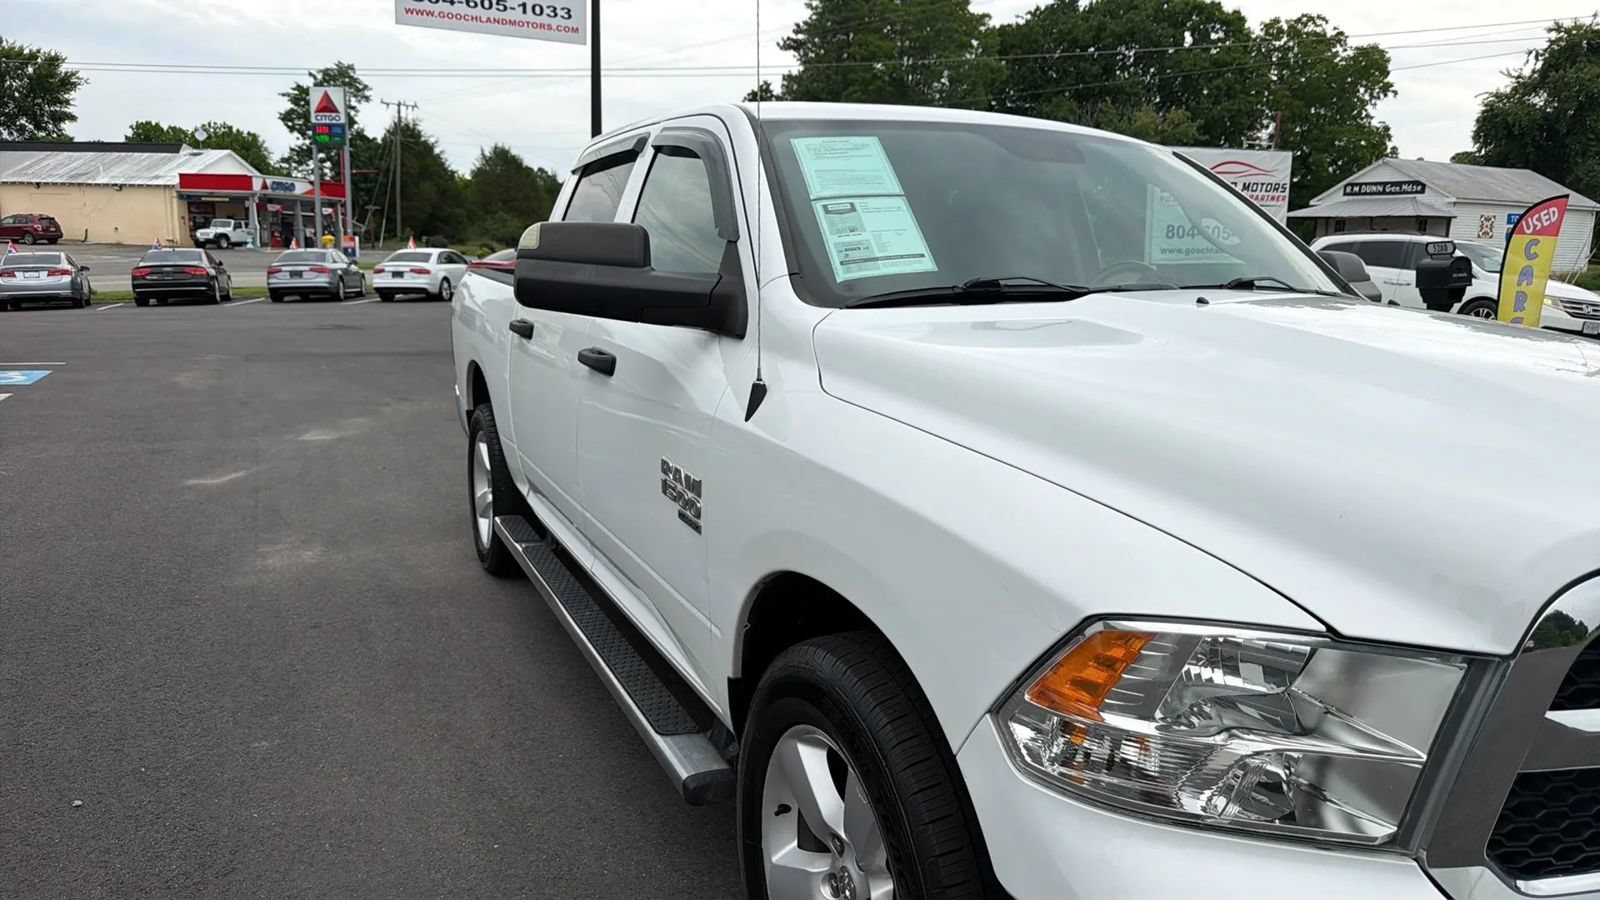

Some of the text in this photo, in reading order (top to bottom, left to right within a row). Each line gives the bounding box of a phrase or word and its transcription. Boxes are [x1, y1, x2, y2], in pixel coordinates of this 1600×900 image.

[404, 7, 580, 34] WWW.GOOCHLANDMOTORS.COM
[411, 0, 573, 20] -605-1033
[314, 114, 341, 122] CITGO
[1241, 182, 1288, 193] MOTORS
[1361, 184, 1384, 193] DUNN
[1522, 206, 1559, 234] USED
[661, 456, 702, 500] RAM
[661, 478, 702, 521] 1500
